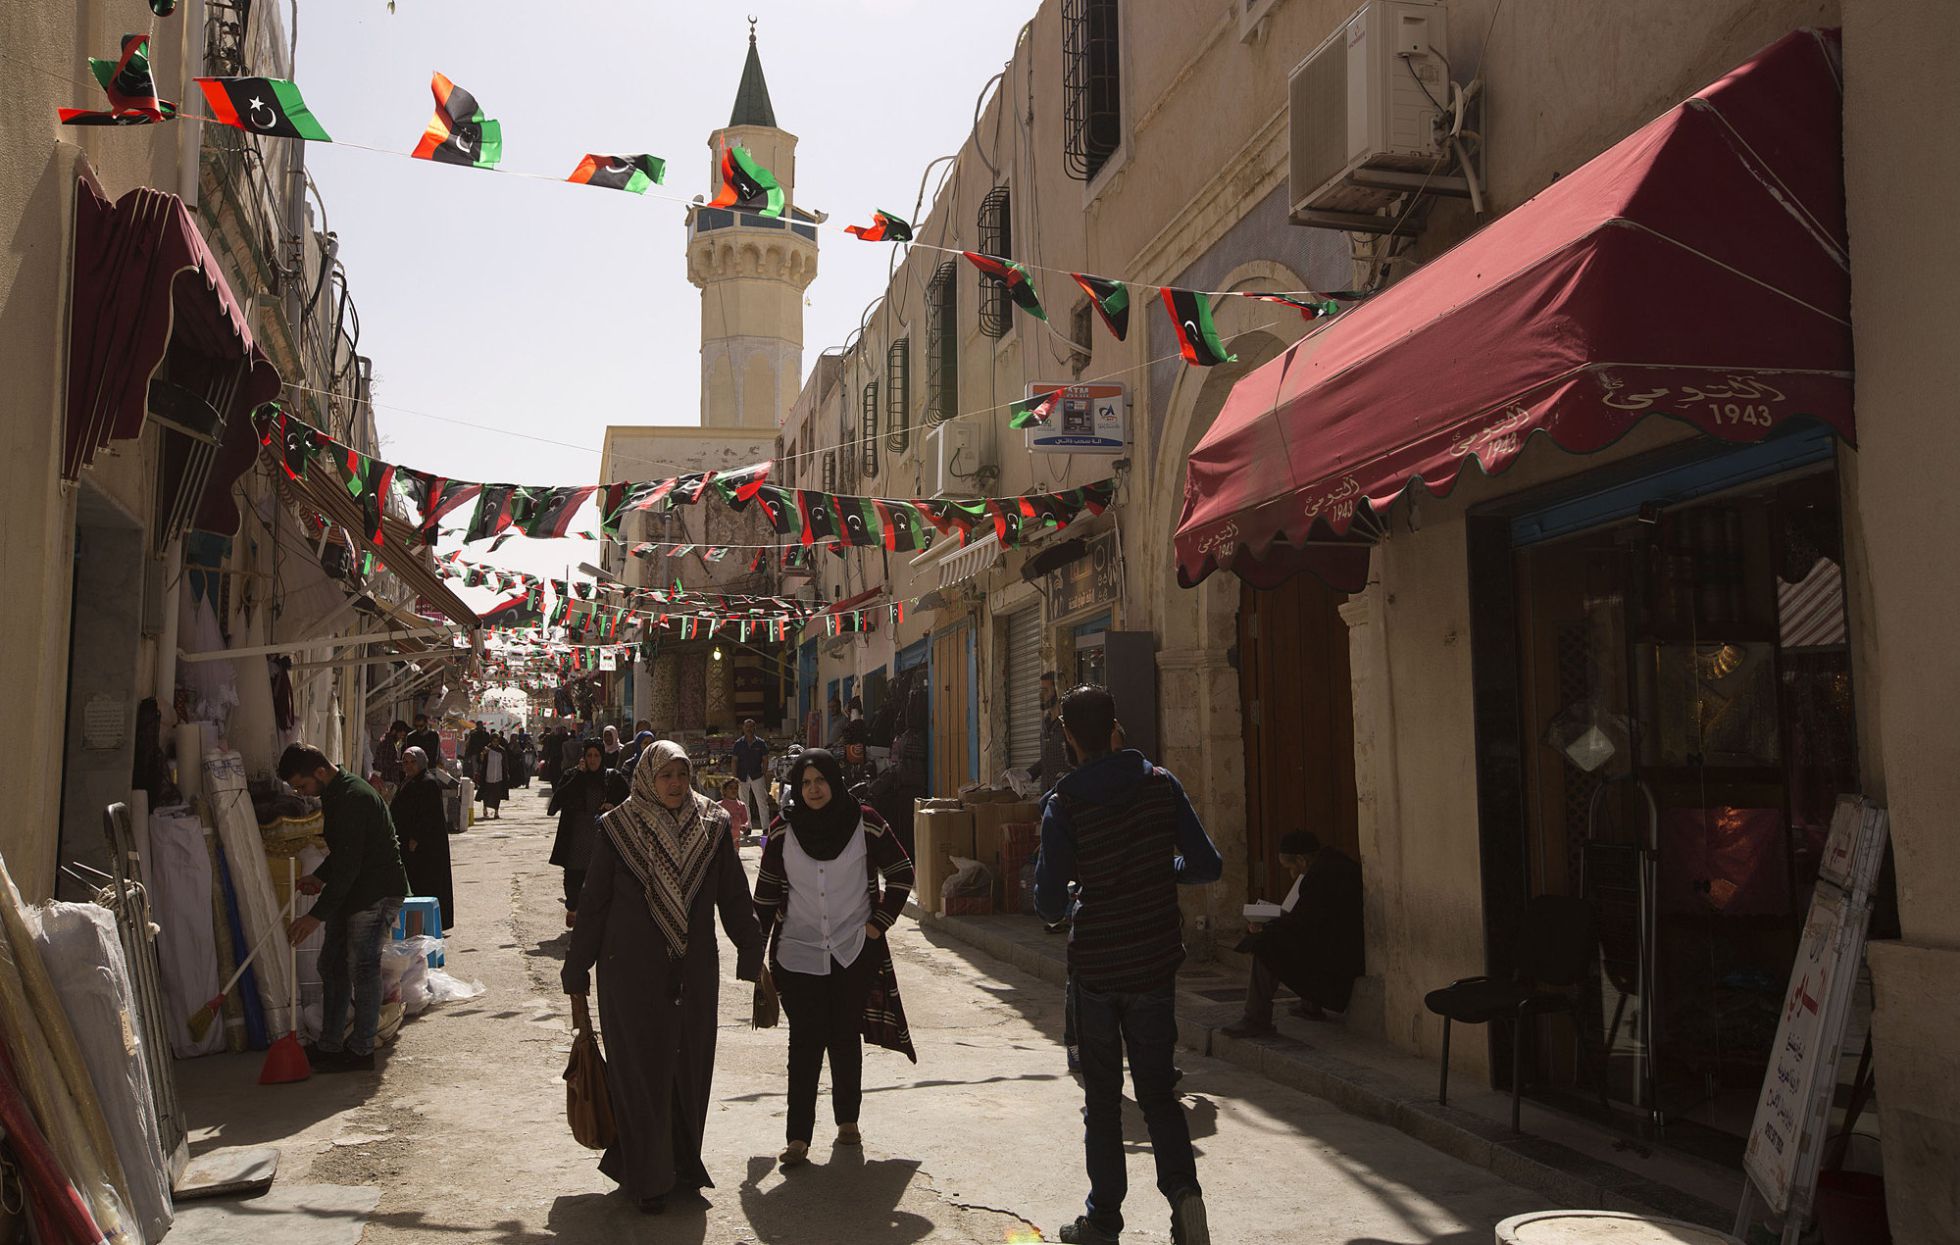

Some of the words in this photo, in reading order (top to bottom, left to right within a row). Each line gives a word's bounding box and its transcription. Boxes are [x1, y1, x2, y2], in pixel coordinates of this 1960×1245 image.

[1709, 404, 1772, 428] 1943
[1486, 431, 1518, 460] 1943
[1332, 499, 1353, 523] 1943
[1217, 540, 1234, 560] 1943
